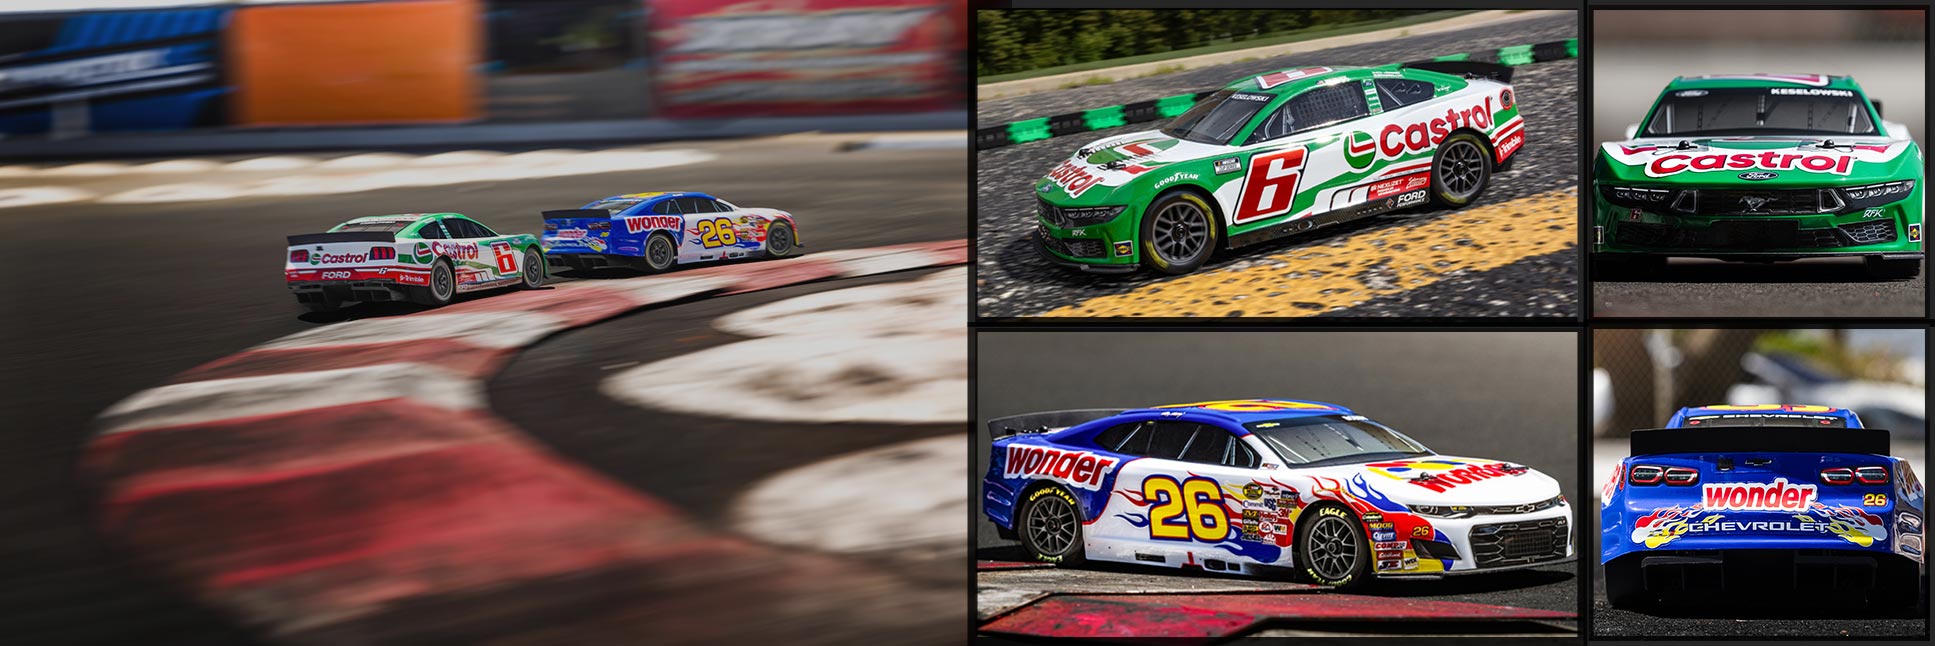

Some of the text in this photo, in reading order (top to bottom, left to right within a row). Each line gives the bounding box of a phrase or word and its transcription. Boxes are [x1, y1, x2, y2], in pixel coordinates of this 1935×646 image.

[1770, 88, 1853, 97] KESELOWSKI
[1380, 96, 1492, 157] Castrol
[1651, 152, 1851, 174] Castrol
[1154, 172, 1199, 190] GOODYEAR
[1237, 149, 1305, 221] 6
[1397, 190, 1426, 203] FORD
[1629, 208, 1642, 221] 6
[626, 217, 681, 232] wonder
[699, 218, 737, 248] 26
[321, 253, 368, 264] Castrol
[492, 241, 518, 275] 6
[322, 271, 351, 280] FORD
[1007, 447, 1113, 486] wonder
[1706, 482, 1813, 509] wonder
[1864, 494, 1886, 506] 26
[1143, 476, 1230, 541] 26
[1319, 507, 1348, 519] EAGLE
[1413, 526, 1430, 537] 26
[1688, 521, 1828, 533] CHEVROLET
